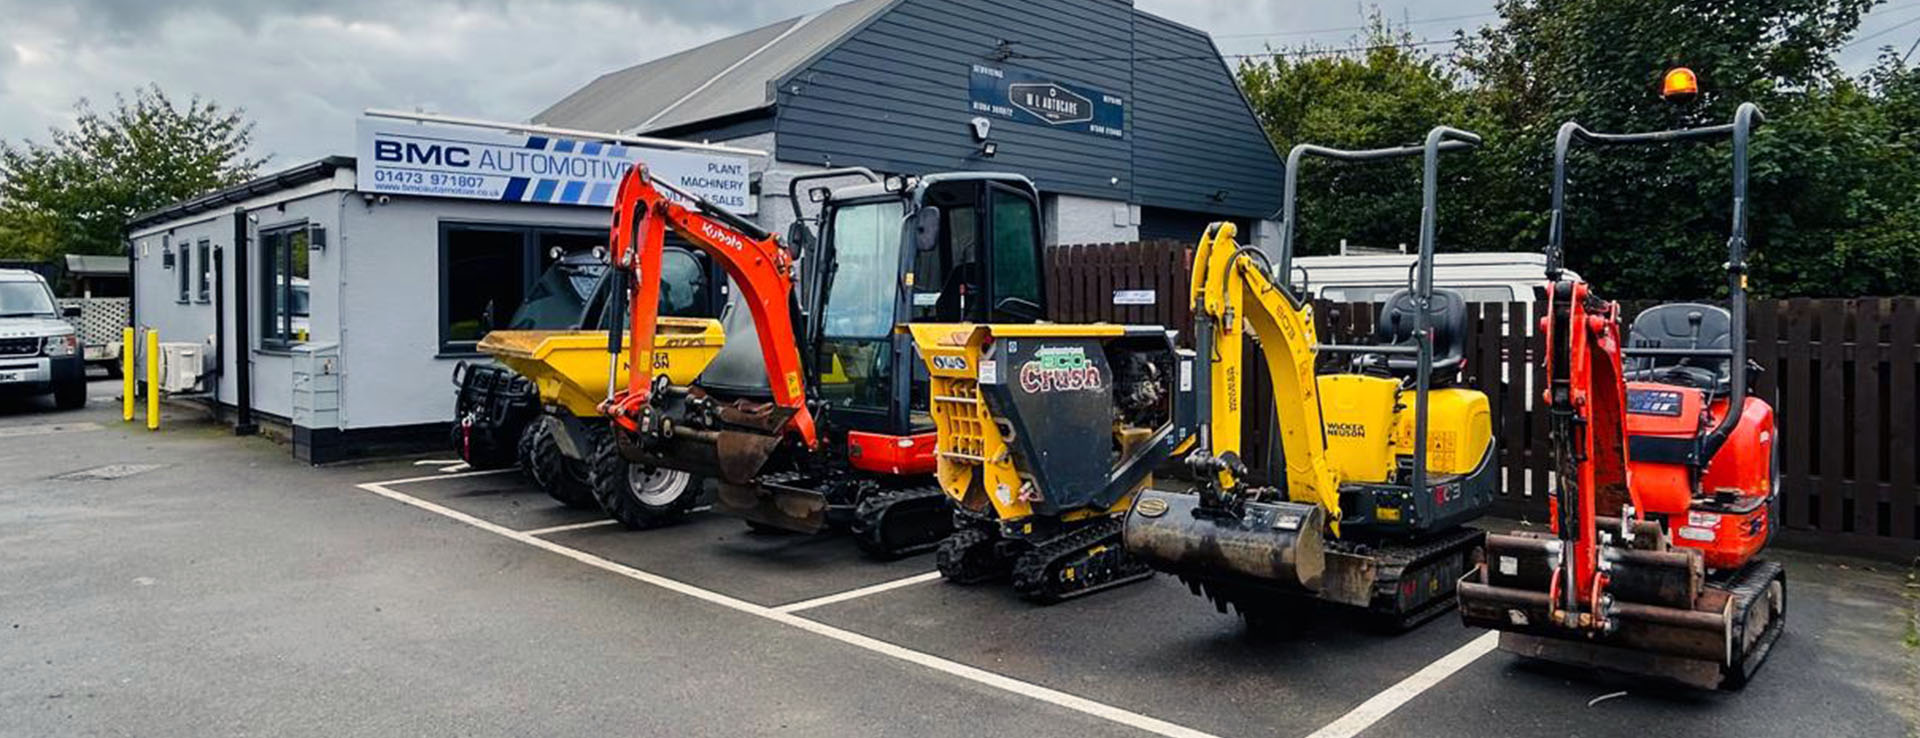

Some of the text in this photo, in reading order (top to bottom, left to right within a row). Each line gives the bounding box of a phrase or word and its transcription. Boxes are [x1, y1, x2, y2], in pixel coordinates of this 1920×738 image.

[375, 140, 470, 168] BMC
[375, 170, 484, 188] 01473 971807
[681, 176, 744, 191] MACHINERY
[712, 194, 744, 207] SALES
[702, 222, 743, 251] Kubota
